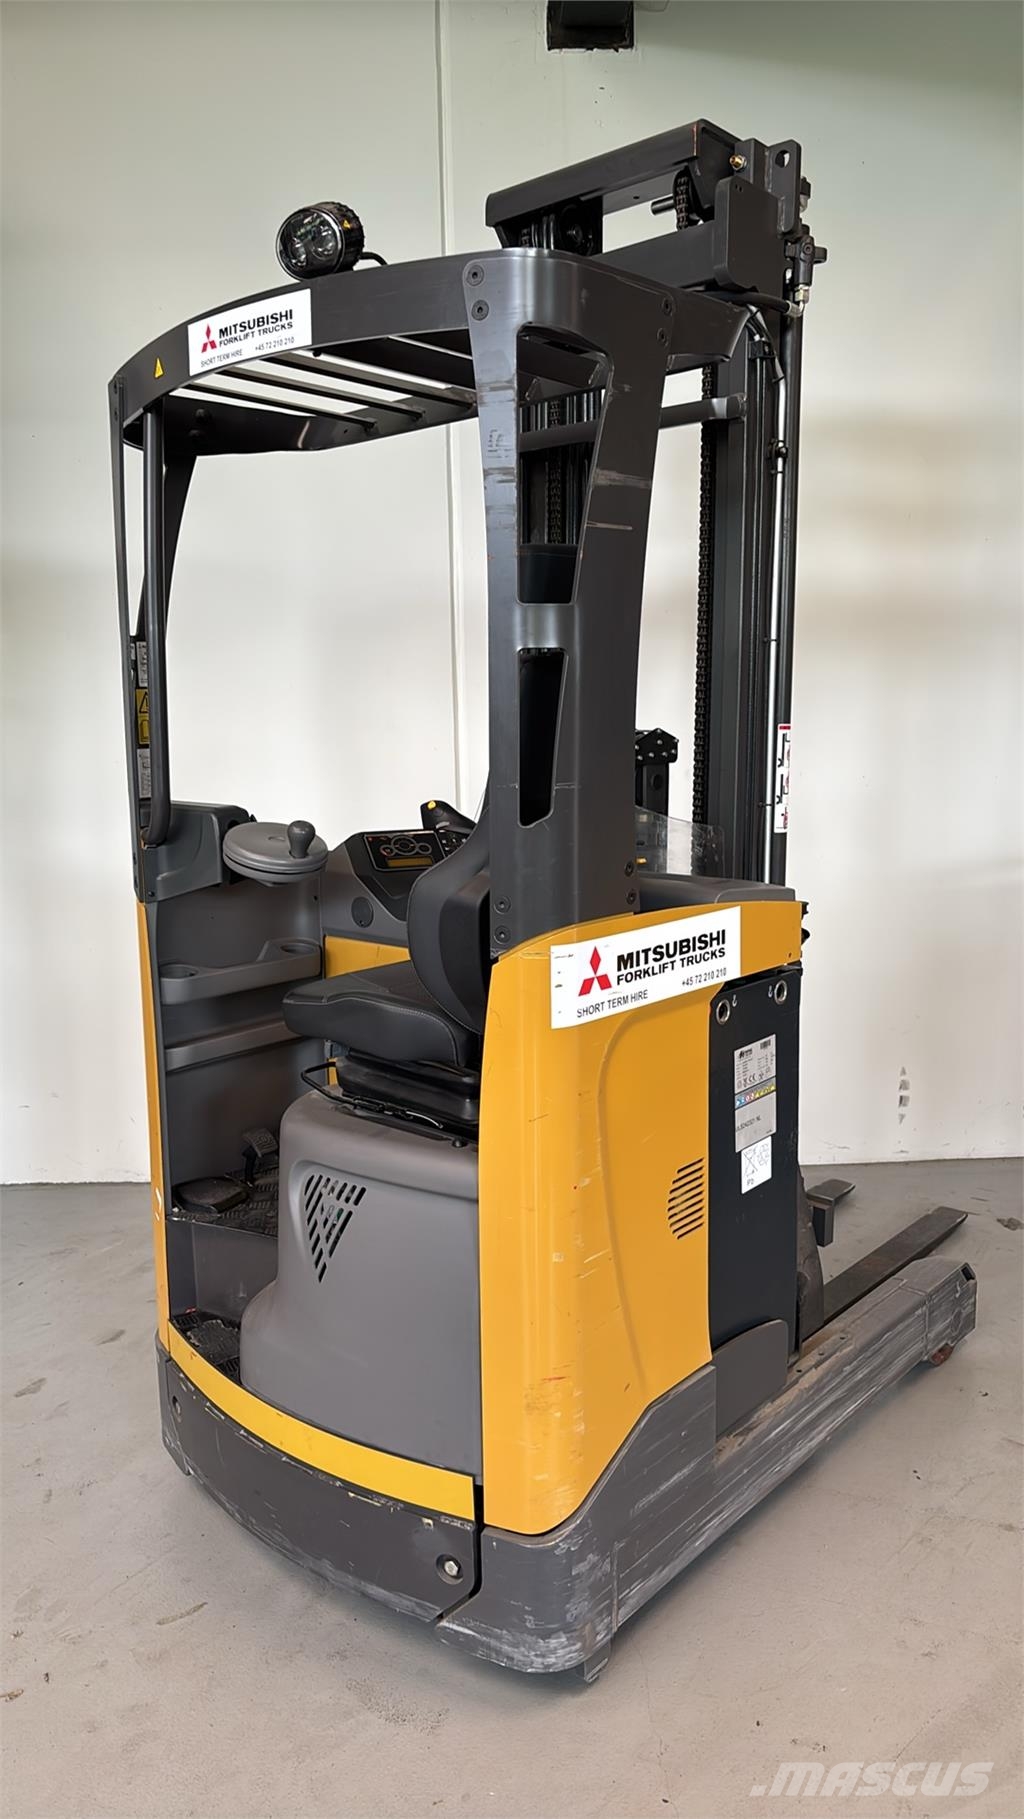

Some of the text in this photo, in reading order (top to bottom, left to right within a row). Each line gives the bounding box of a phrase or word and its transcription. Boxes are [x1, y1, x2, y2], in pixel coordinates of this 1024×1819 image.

[218, 309, 293, 339] MITSUBISHI
[219, 321, 293, 348] FORKLIFT TRUCKS
[254, 336, 295, 351] +45 72 210 210
[200, 348, 243, 368] SHORT TERM HIRE
[616, 929, 726, 972] MITSUBISHI
[616, 947, 726, 986] FORKLIFT TRUCKS
[681, 967, 727, 987] +45 72 210 210
[576, 989, 649, 1018] SHORT TERM HIRE
